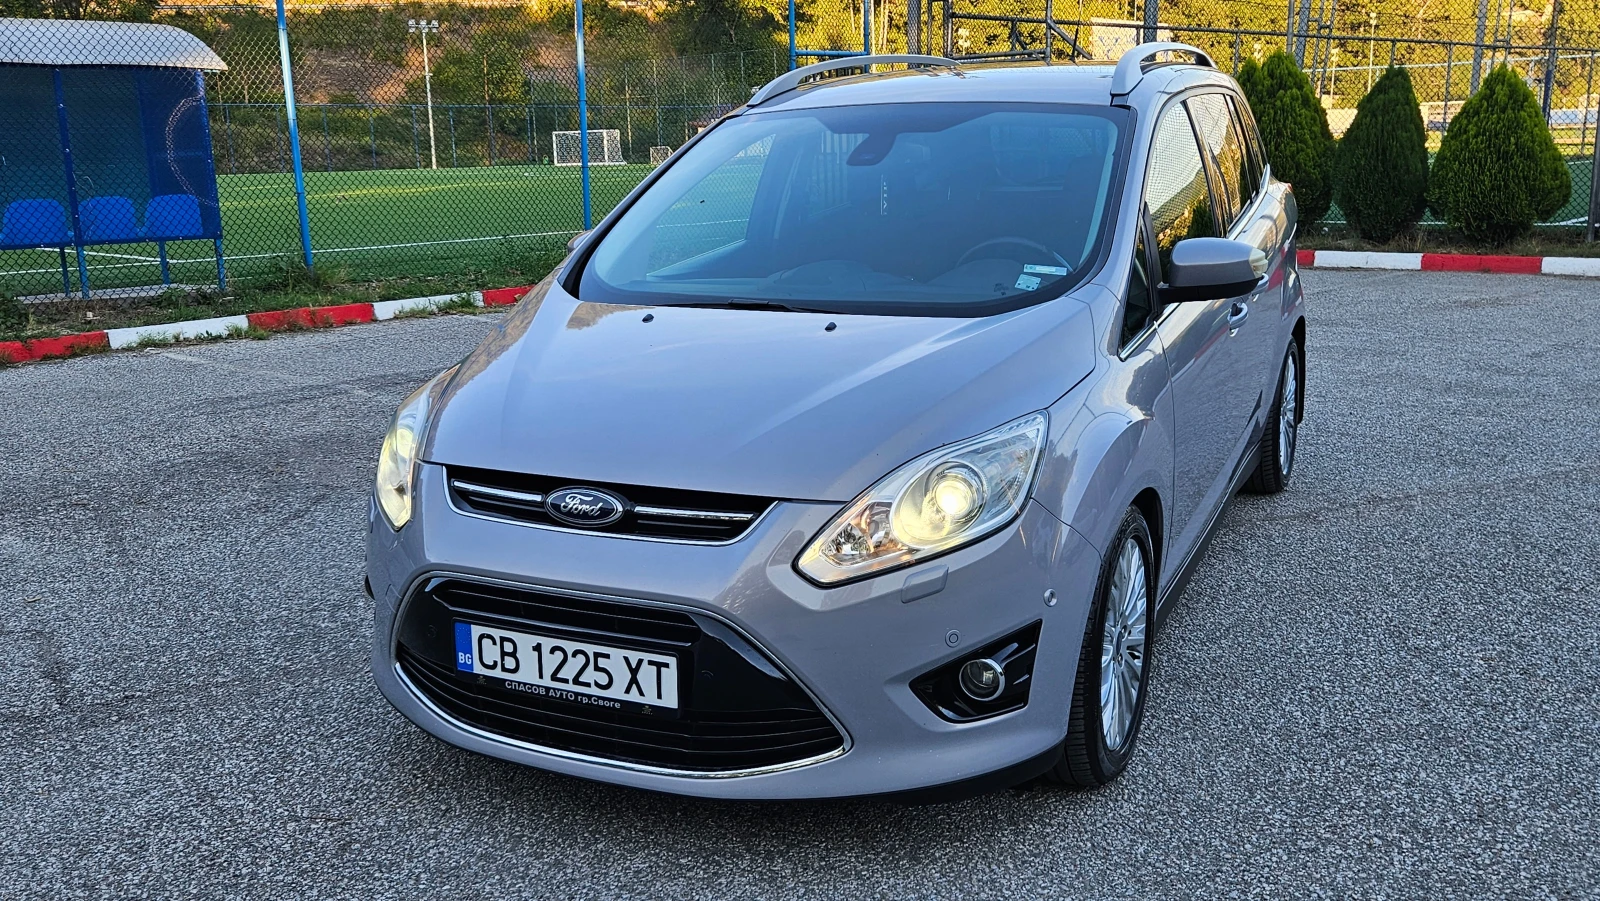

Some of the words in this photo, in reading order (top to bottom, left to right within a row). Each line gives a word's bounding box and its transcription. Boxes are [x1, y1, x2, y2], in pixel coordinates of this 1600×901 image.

[560, 493, 604, 517] Ford
[458, 651, 472, 665] BG
[477, 632, 520, 674] CB
[532, 642, 614, 691] 1225
[622, 655, 670, 700] XT
[505, 680, 546, 695] СПАСОВ
[548, 688, 575, 700] АУТО
